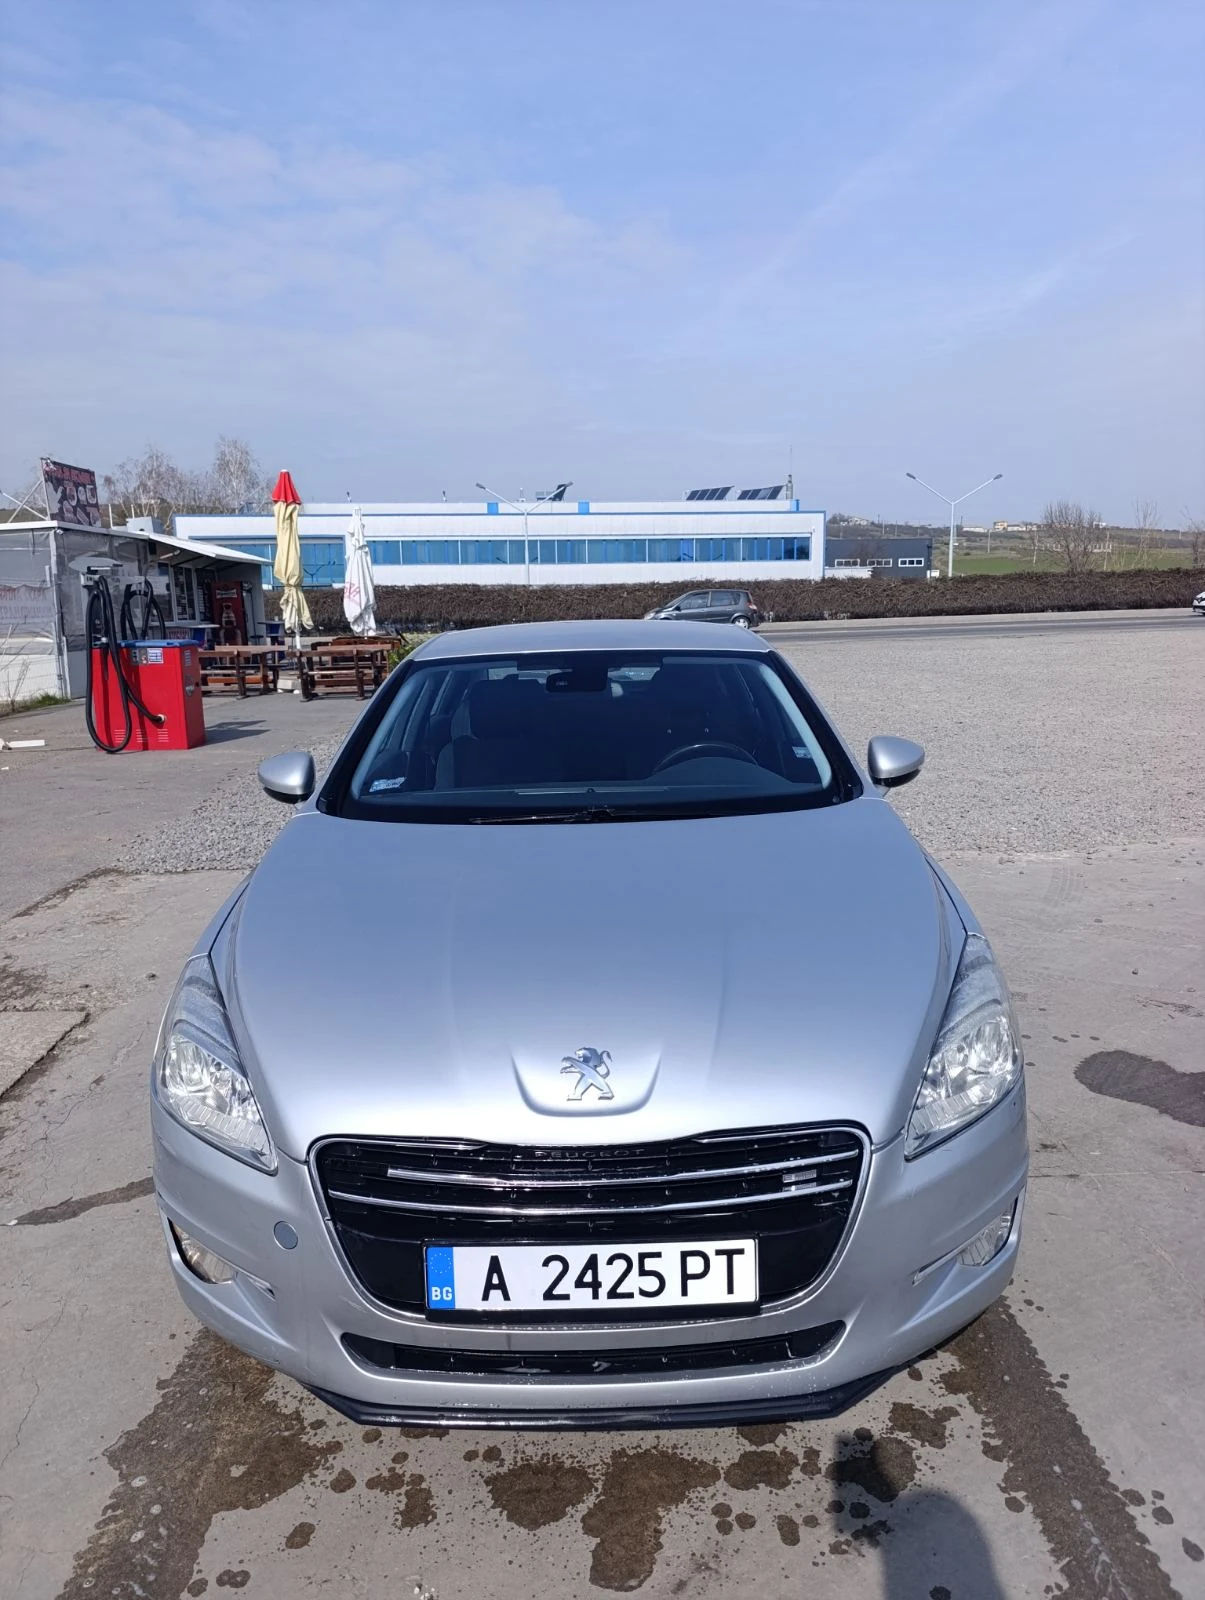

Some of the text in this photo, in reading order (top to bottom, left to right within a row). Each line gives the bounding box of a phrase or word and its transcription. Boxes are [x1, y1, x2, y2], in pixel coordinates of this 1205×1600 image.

[481, 1248, 745, 1302] A 2425 PT
[431, 1286, 453, 1301] BG
